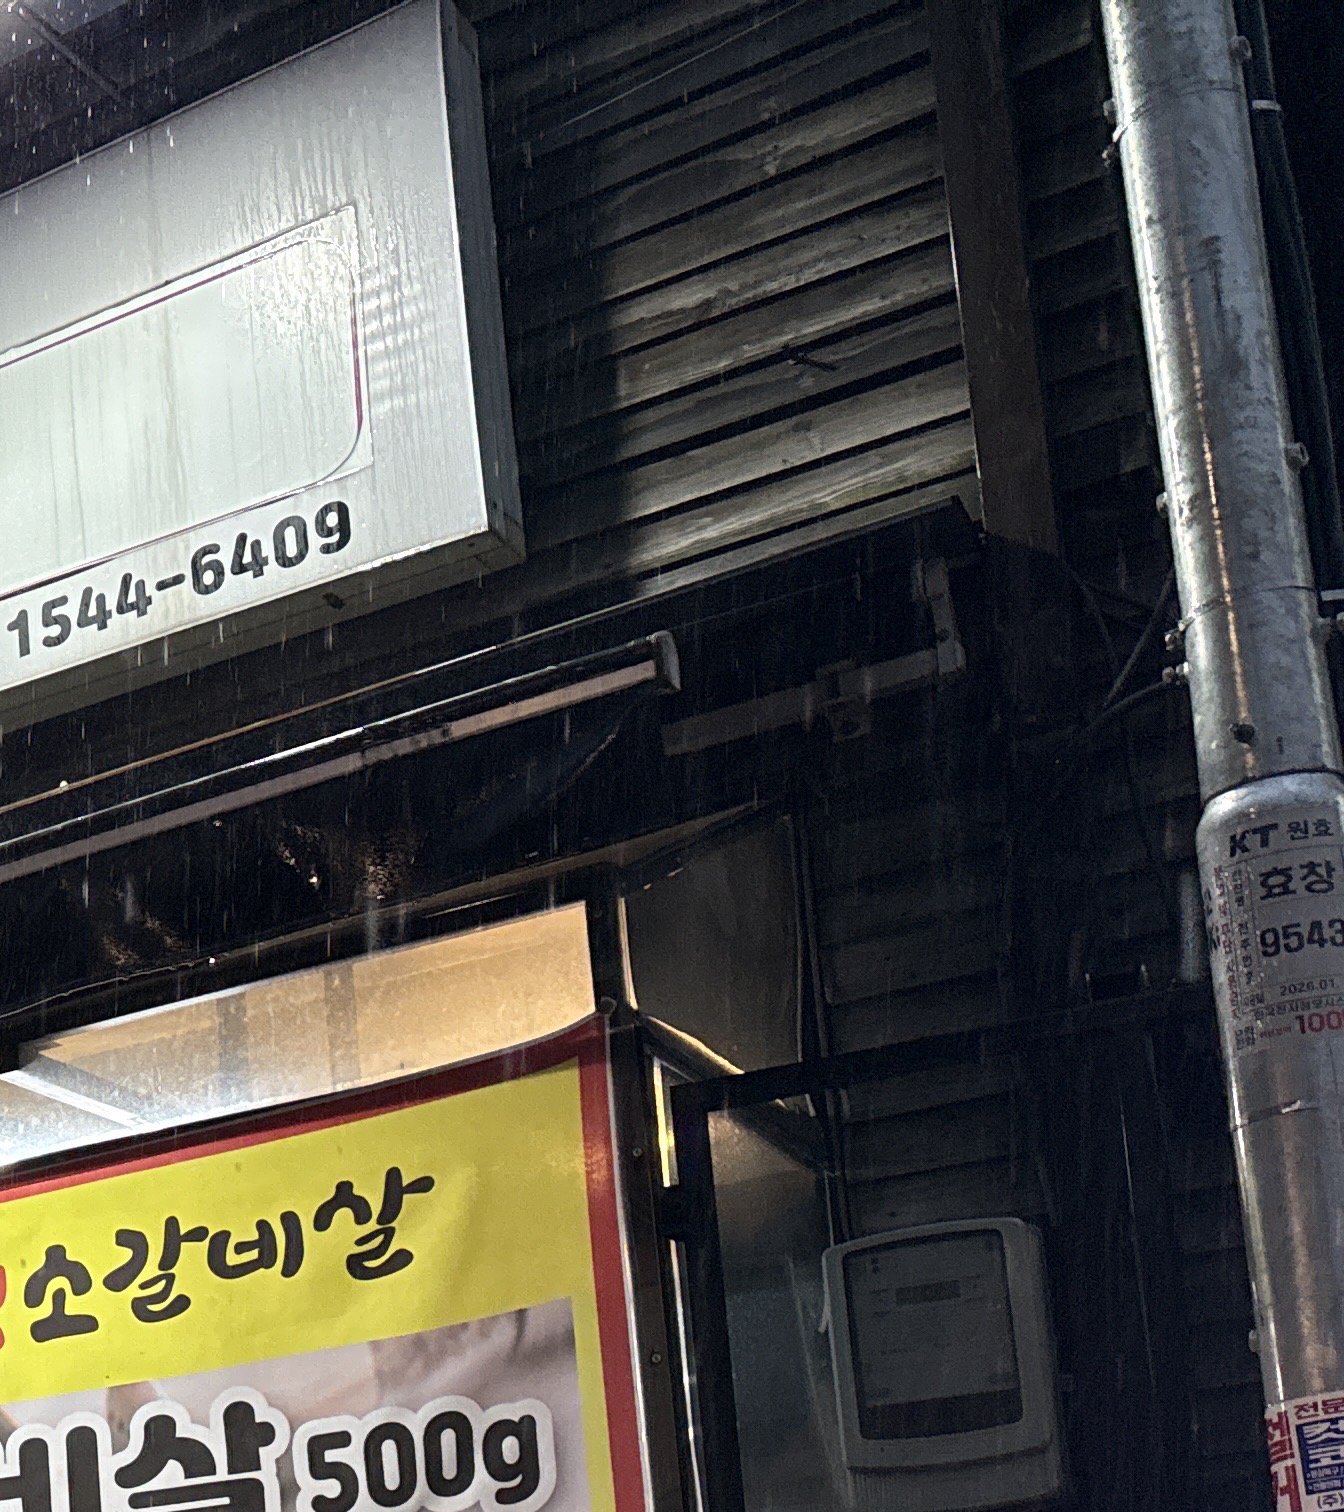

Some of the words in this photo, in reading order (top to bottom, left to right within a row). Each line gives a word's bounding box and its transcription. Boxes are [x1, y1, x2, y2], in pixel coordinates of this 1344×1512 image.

[7, 499, 353, 660] 1544-6409
[1229, 822, 1279, 858] KT
[1286, 818, 1334, 841] 원효
[1295, 1008, 1344, 1035] 100
[22, 1166, 436, 1346] 소갈비살
